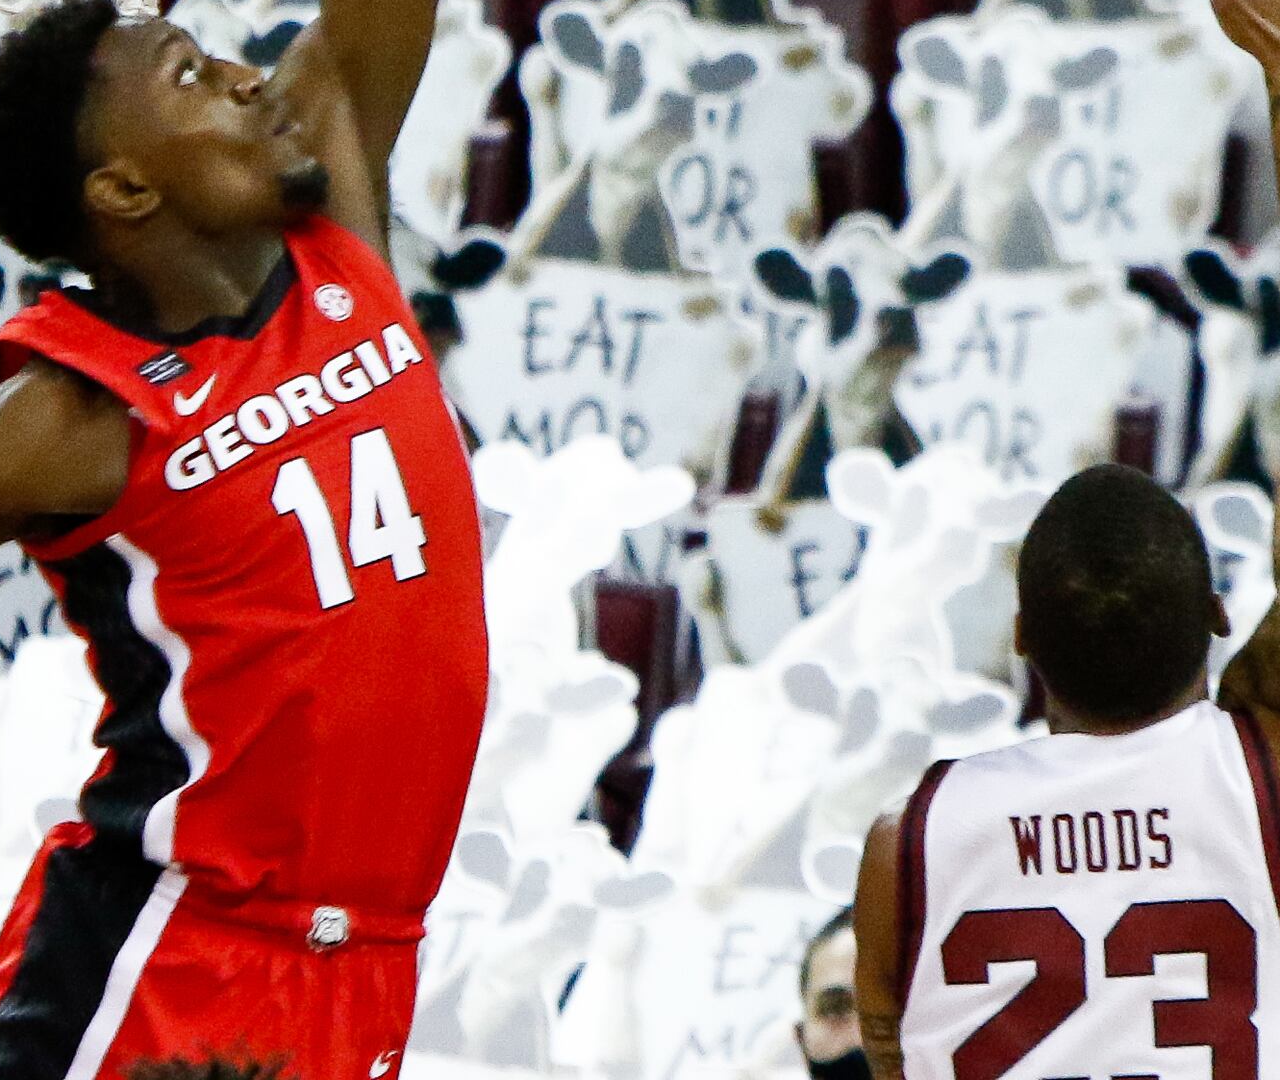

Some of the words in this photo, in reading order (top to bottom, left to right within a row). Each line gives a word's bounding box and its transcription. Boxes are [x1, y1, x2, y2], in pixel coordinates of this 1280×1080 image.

[163, 321, 424, 492] GEORGIA
[522, 294, 665, 384] EAT
[270, 426, 428, 610] 14
[1008, 808, 1173, 875] WOODS
[940, 898, 1259, 1080] 23
